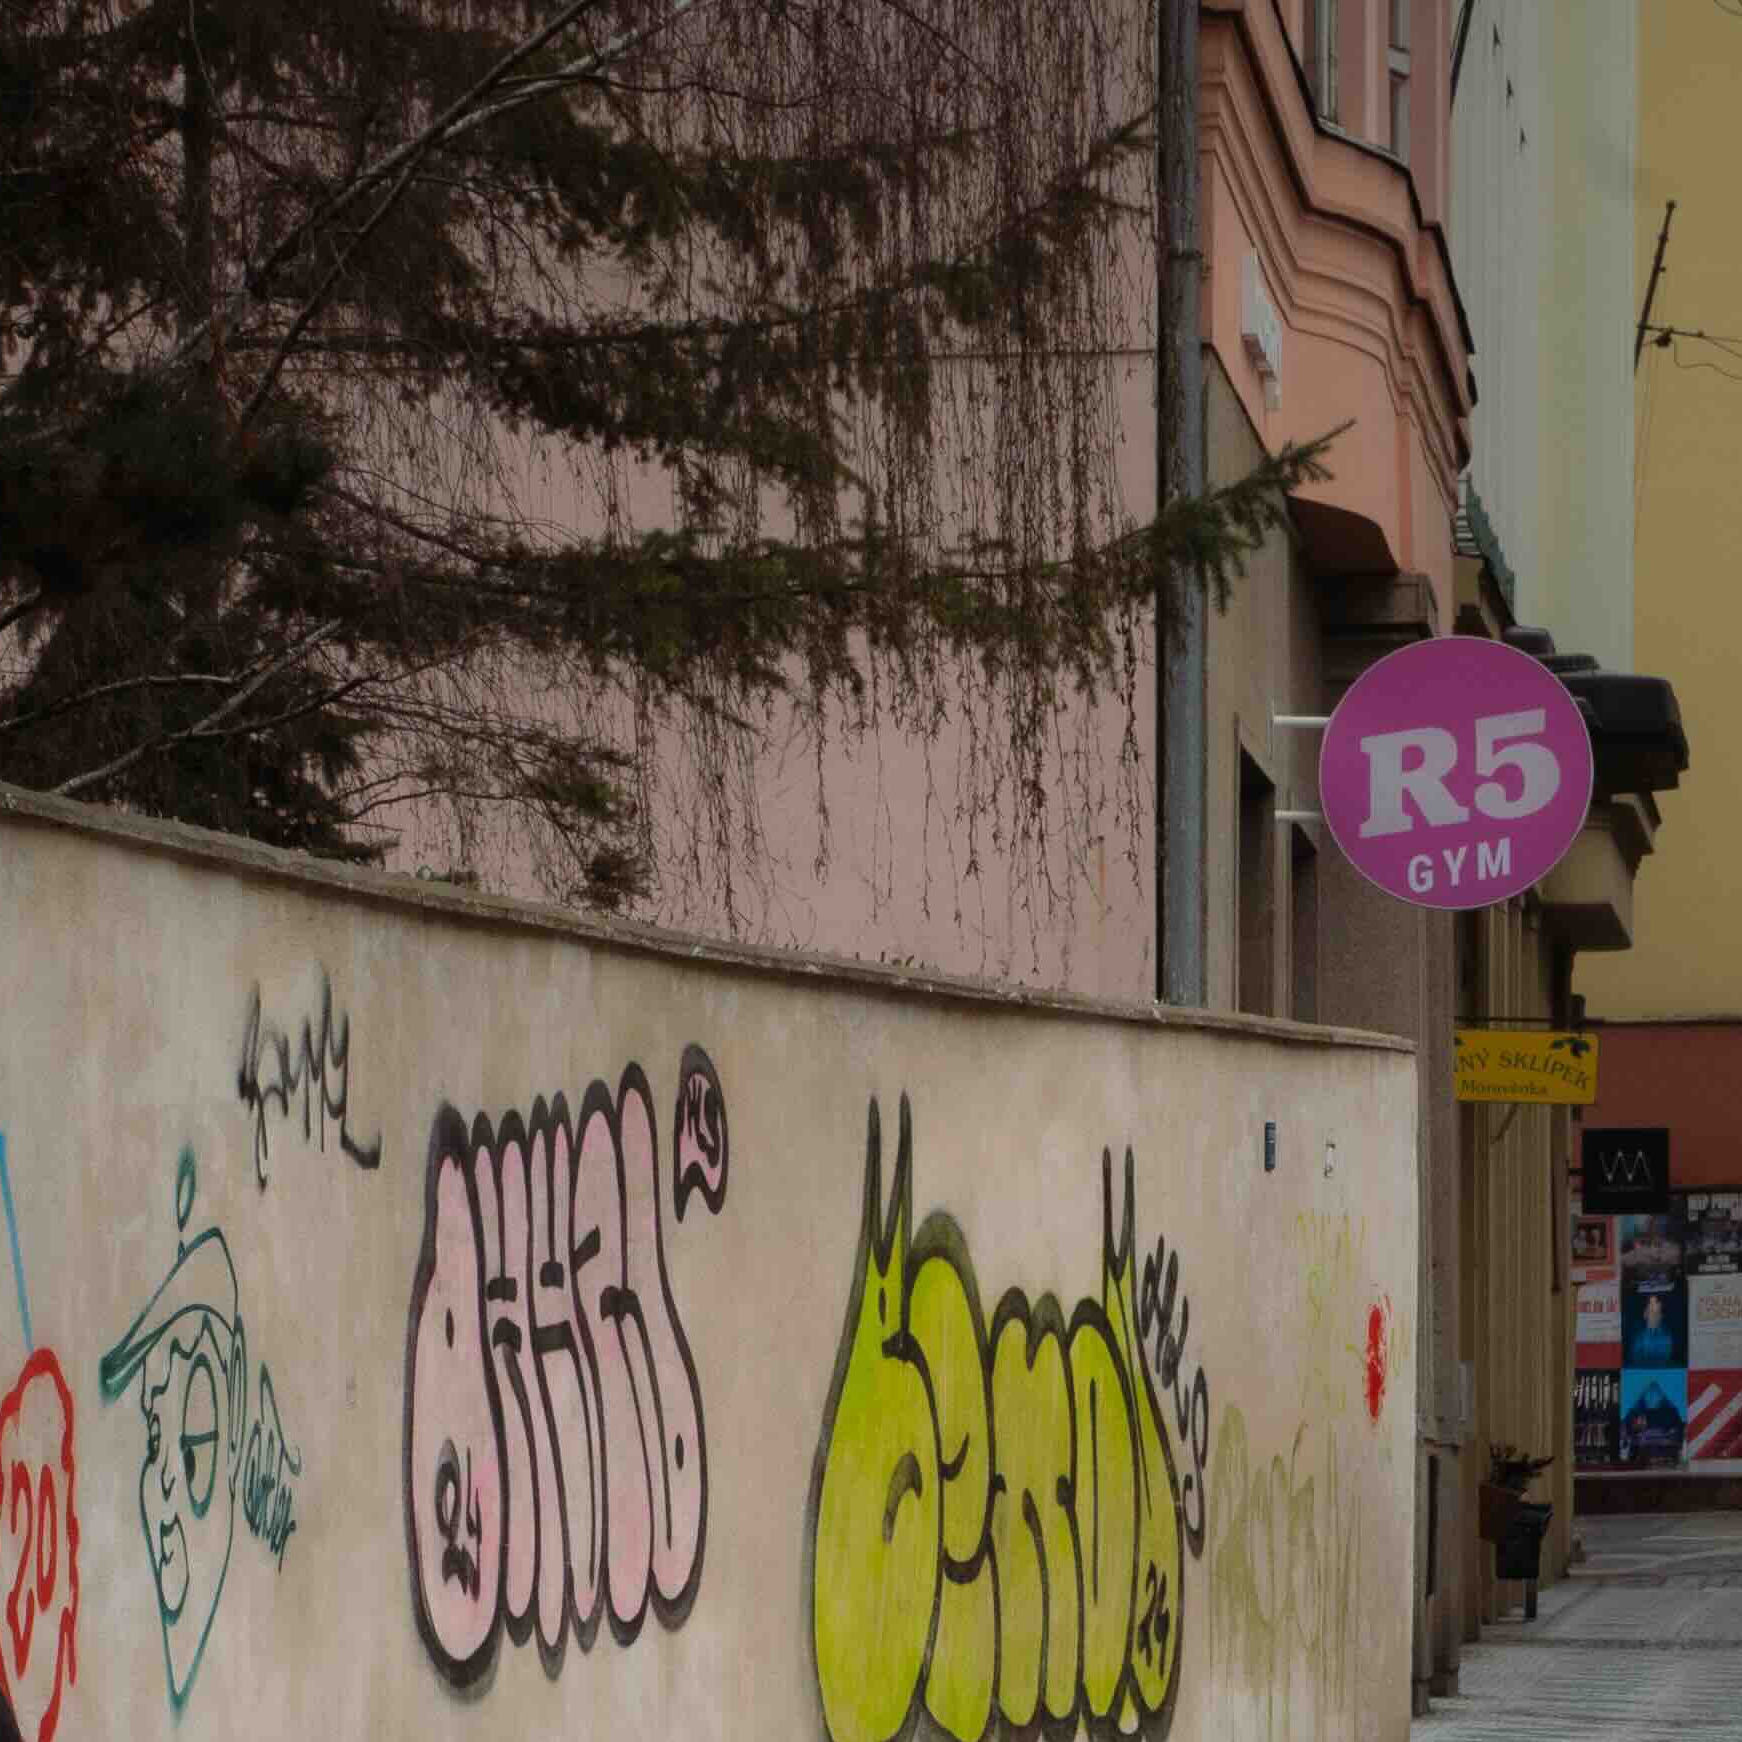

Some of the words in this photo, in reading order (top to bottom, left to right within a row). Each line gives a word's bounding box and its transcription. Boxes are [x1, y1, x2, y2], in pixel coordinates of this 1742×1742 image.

[1359, 708, 1561, 838] R5
[1407, 837, 1511, 894] GYM
[6, 1460, 57, 1680] 20
